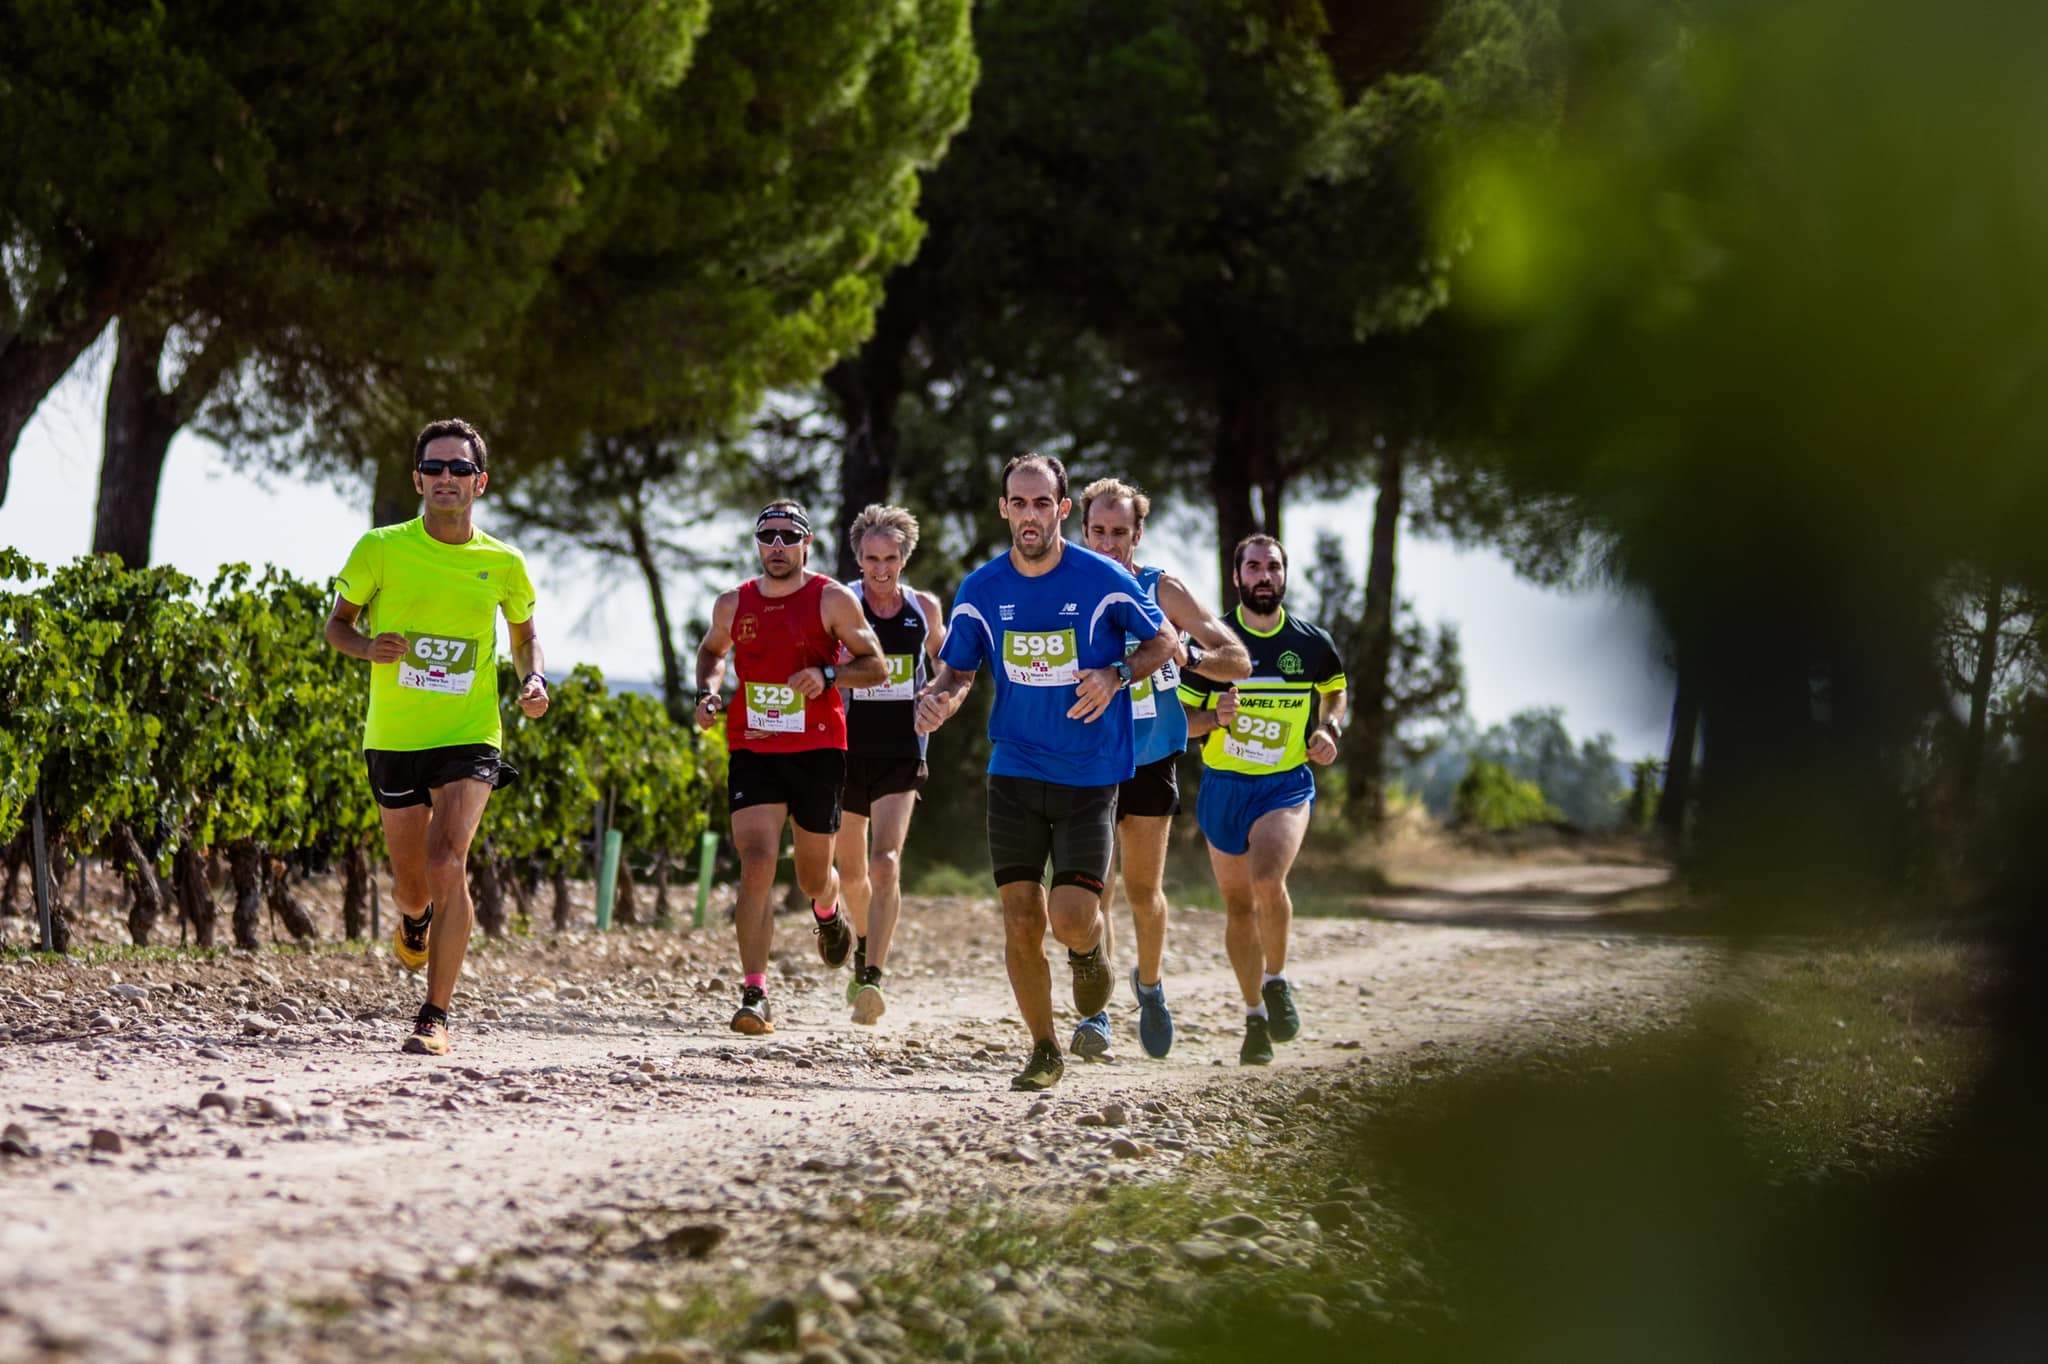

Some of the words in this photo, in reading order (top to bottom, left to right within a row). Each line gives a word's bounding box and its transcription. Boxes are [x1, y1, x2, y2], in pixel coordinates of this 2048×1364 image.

[415, 637, 467, 662] 637
[1013, 634, 1065, 656] 598
[753, 685, 795, 705] 329
[1278, 699, 1304, 708] TEAM
[1236, 715, 1281, 740] 928
